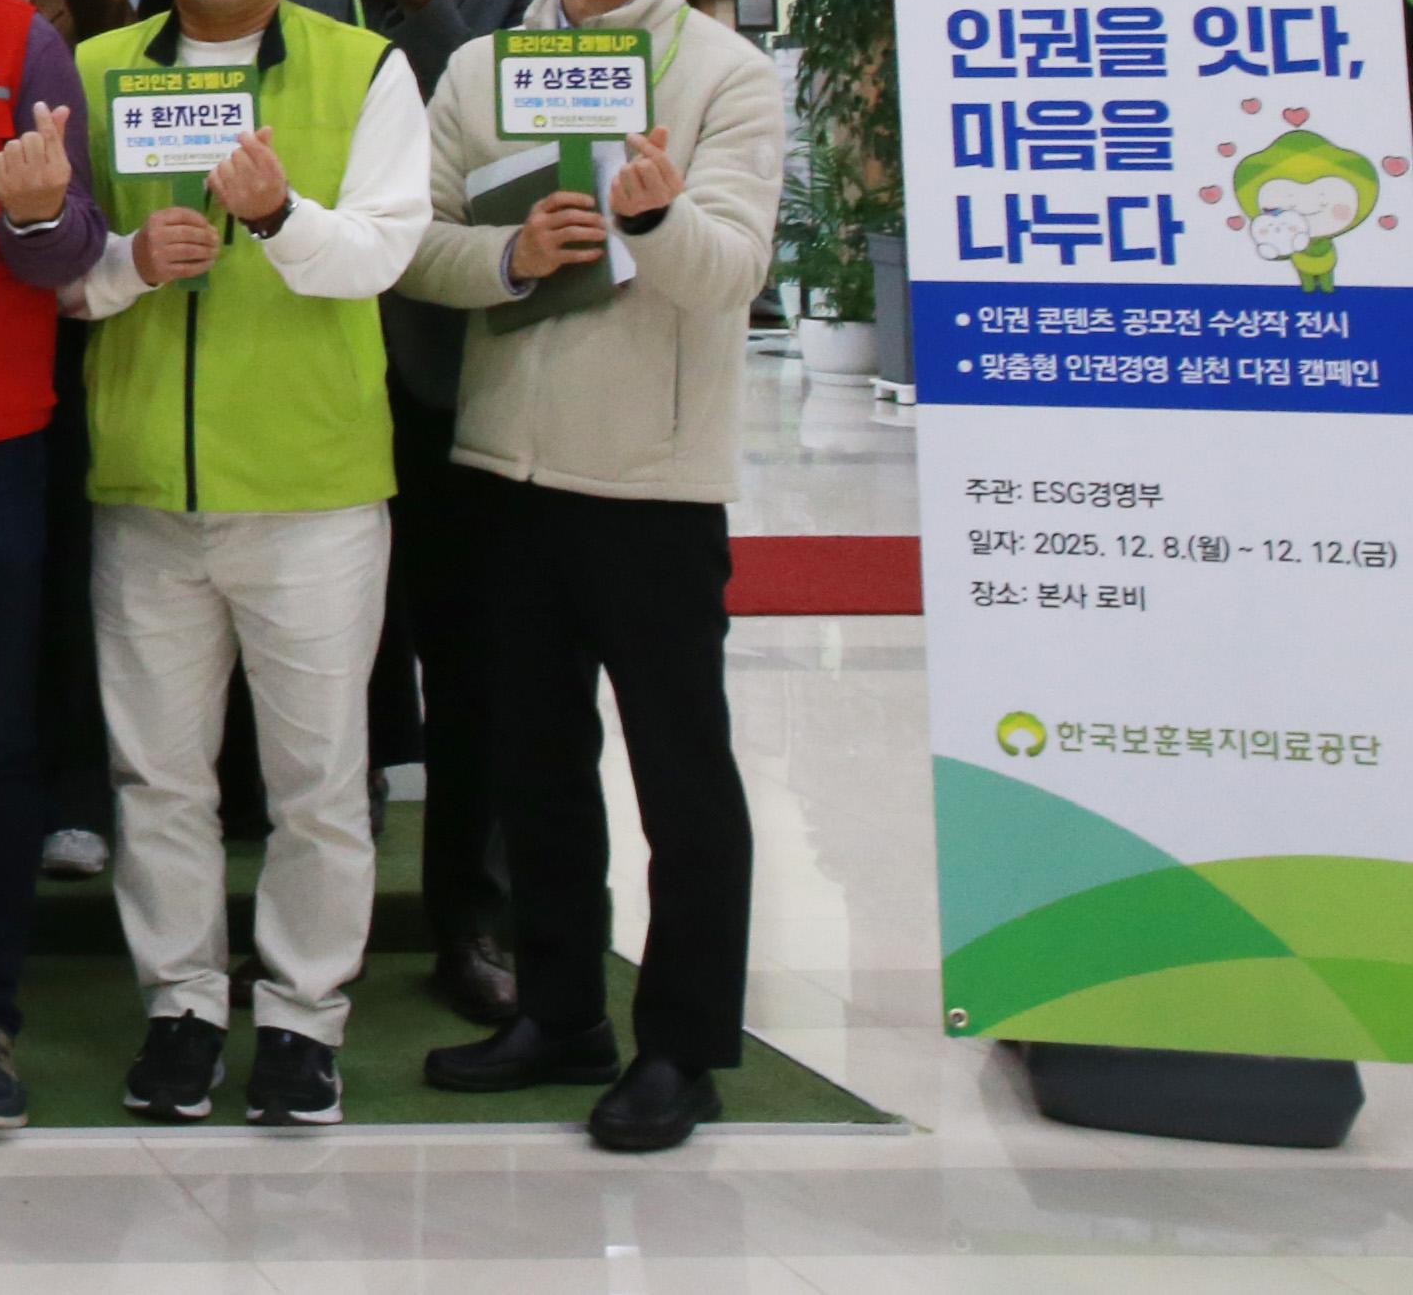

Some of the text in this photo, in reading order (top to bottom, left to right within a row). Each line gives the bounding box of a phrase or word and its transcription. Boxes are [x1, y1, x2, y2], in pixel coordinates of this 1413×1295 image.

[946, 5, 1364, 80] 인권을 잇다,
[514, 67, 632, 90] # 상호존중
[125, 103, 242, 129] # 환자인권
[951, 99, 1174, 171] 마음을
[957, 194, 1185, 265] 나누다
[978, 306, 1350, 339] 인권 콘텐츠 공모전 수상작 전시
[980, 353, 1380, 389] 맞춤형 인권경영 실천 다짐 캠페인
[965, 479, 1164, 508] 주관: ESG경영부
[968, 530, 1025, 556] 일자:
[1034, 533, 1106, 557] 2025.
[1117, 536, 1154, 558] 12.
[1263, 539, 1302, 563] 12.
[971, 581, 1146, 611] 장소: 본사 로비
[1056, 720, 1382, 766] 한국보훈복지의료공단
